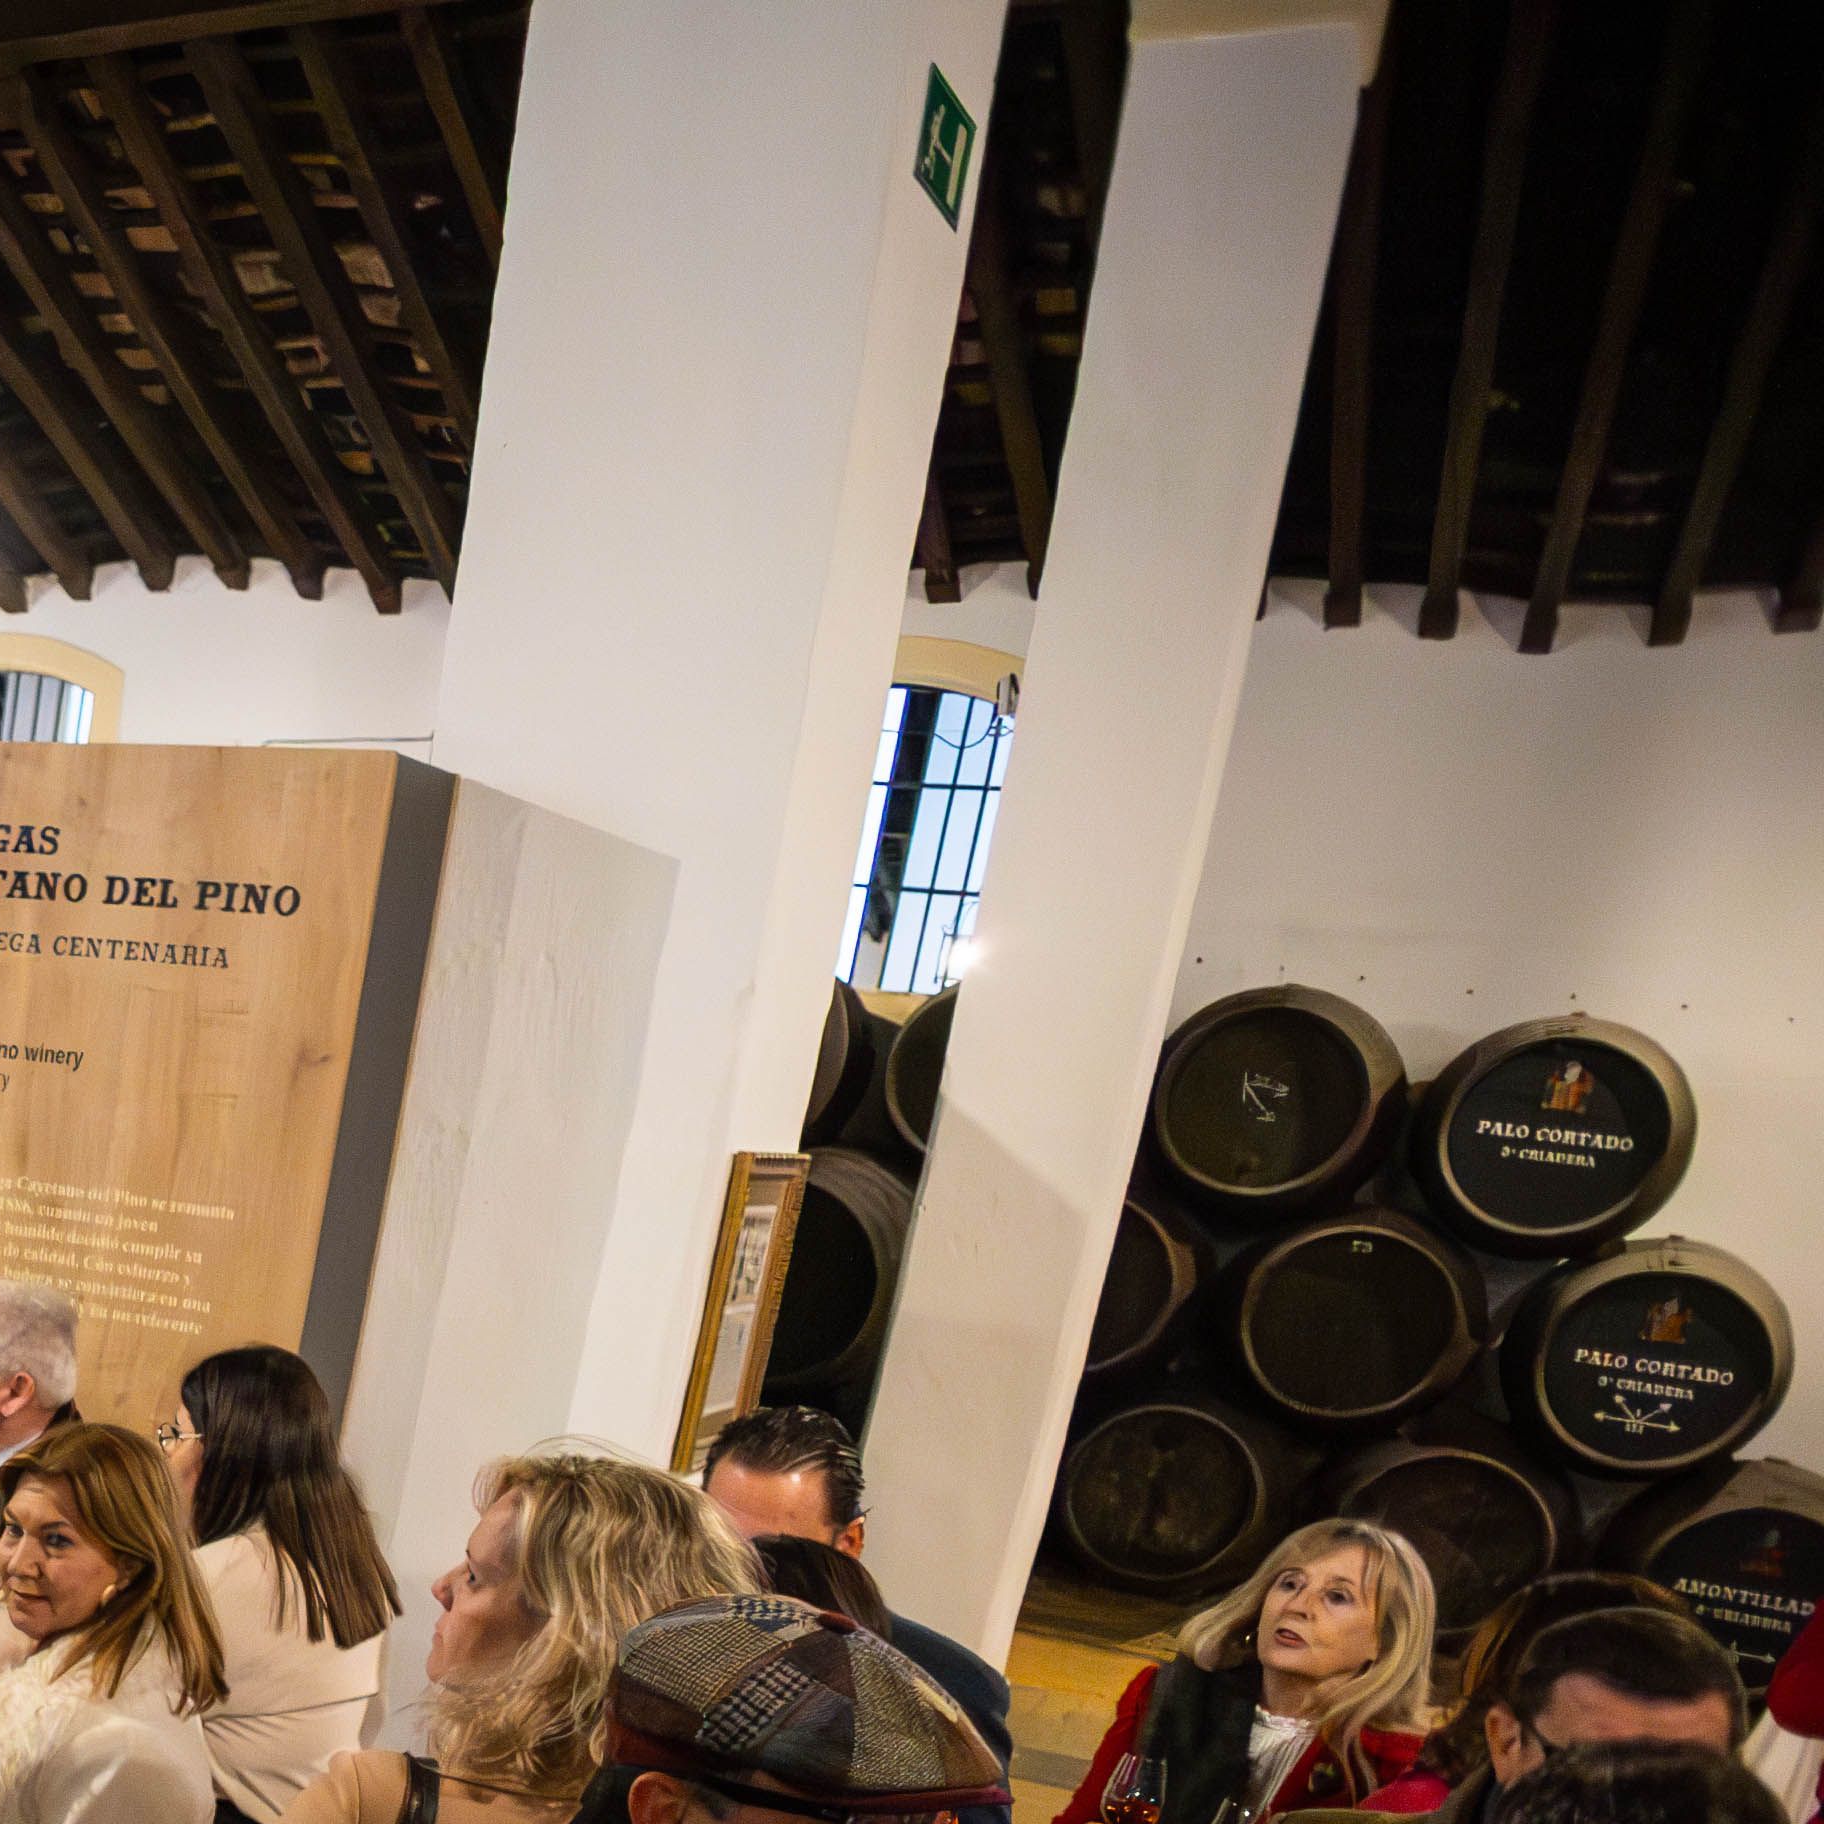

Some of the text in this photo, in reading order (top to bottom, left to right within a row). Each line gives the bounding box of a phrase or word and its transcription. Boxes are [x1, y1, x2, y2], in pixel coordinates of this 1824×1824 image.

[102, 875, 179, 908] DEL
[194, 880, 301, 917] PINO
[52, 935, 229, 968] CENTENARIA
[24, 1043, 84, 1072] winery
[1475, 1119, 1634, 1152] PALO CORTADO
[1518, 1148, 1596, 1169] CRIADERA
[1574, 1348, 1734, 1386] PALO CORTADO
[1616, 1378, 1694, 1401] CRIADERA
[1672, 1577, 1817, 1617] AMONTILLAD
